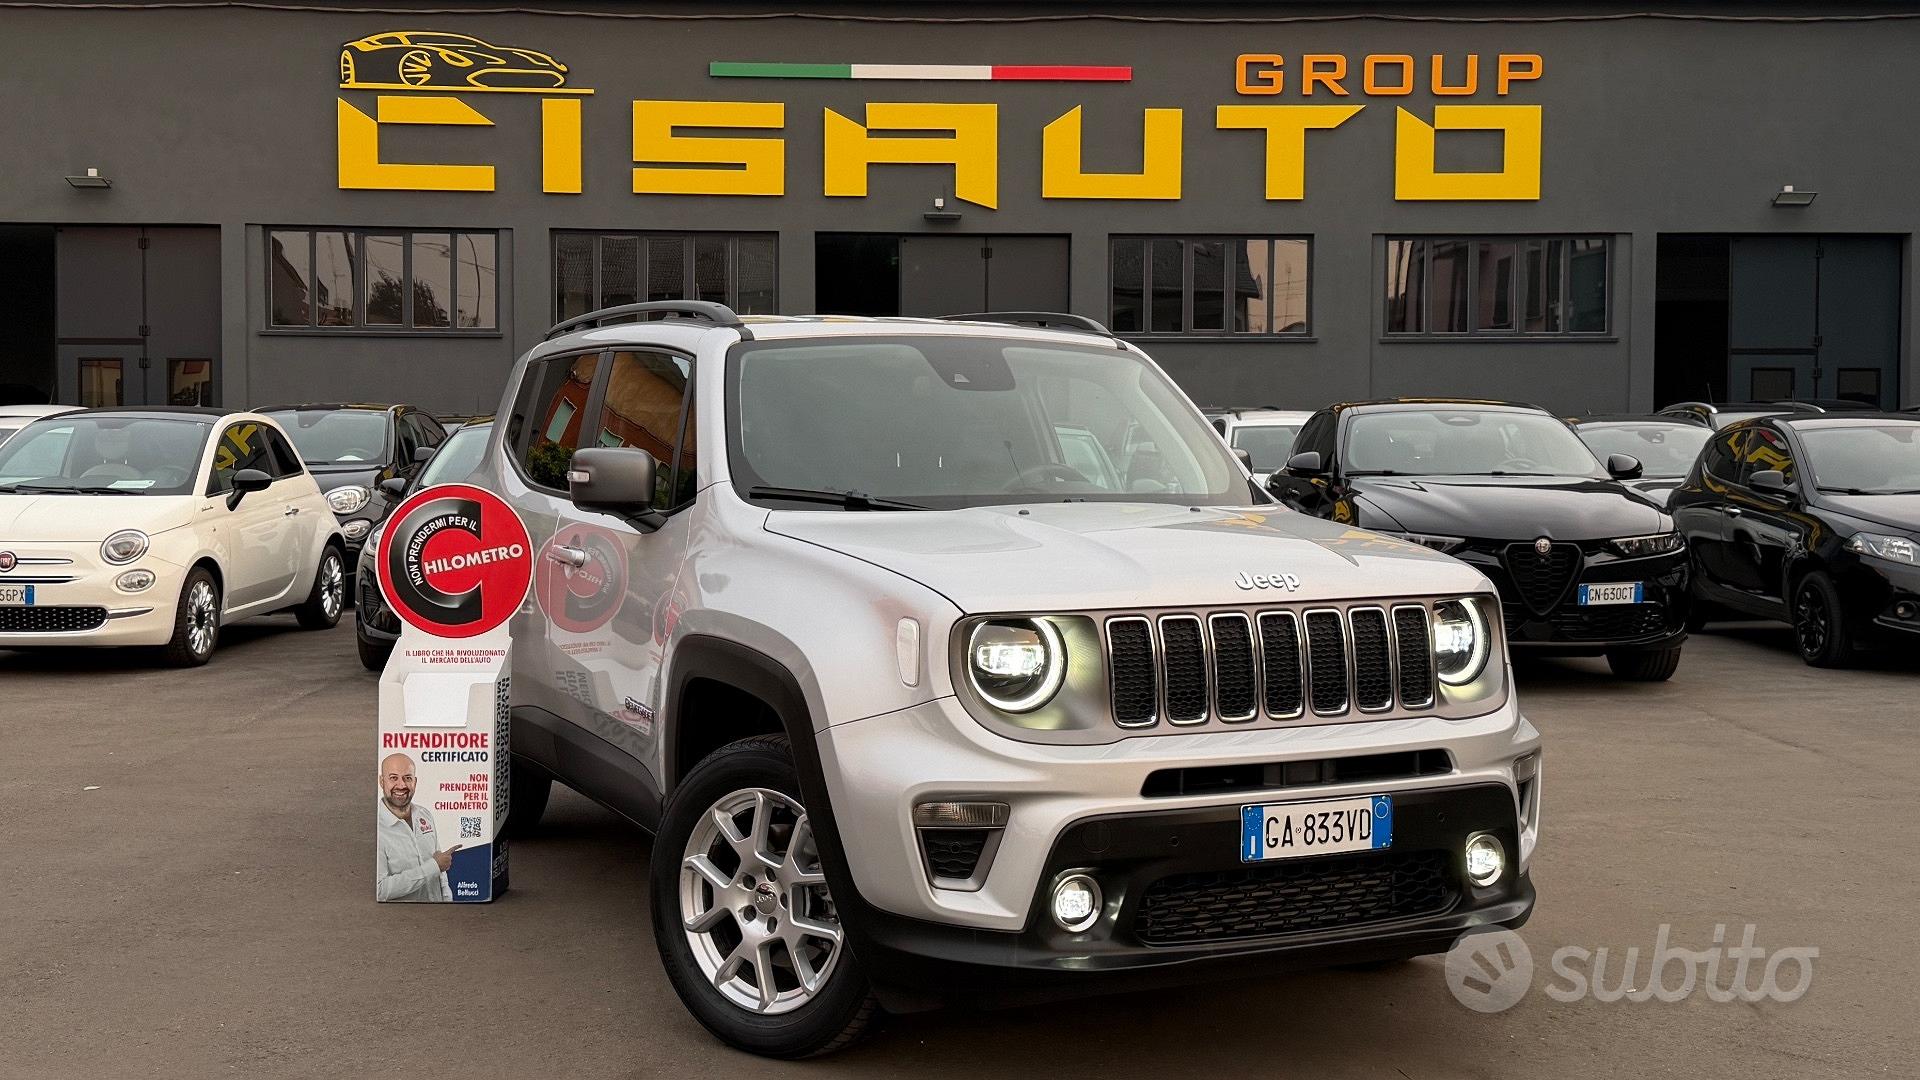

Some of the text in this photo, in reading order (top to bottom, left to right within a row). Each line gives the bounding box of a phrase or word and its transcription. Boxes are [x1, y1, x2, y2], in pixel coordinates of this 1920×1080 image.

[1236, 54, 1543, 95] GROUP
[338, 96, 1543, 209] CISAUTO
[408, 516, 477, 587] NON PRENDERMI PER IL
[1234, 570, 1300, 592] Jeep
[456, 649, 506, 657] RIVOLUZIONATO
[383, 732, 489, 748] RIVENDITORE
[421, 751, 488, 762] CERTIFICATO
[469, 773, 488, 782] NON
[439, 783, 488, 791] PRENDERMI
[463, 792, 488, 800] PER IL
[434, 801, 488, 810] CHILOMETRO
